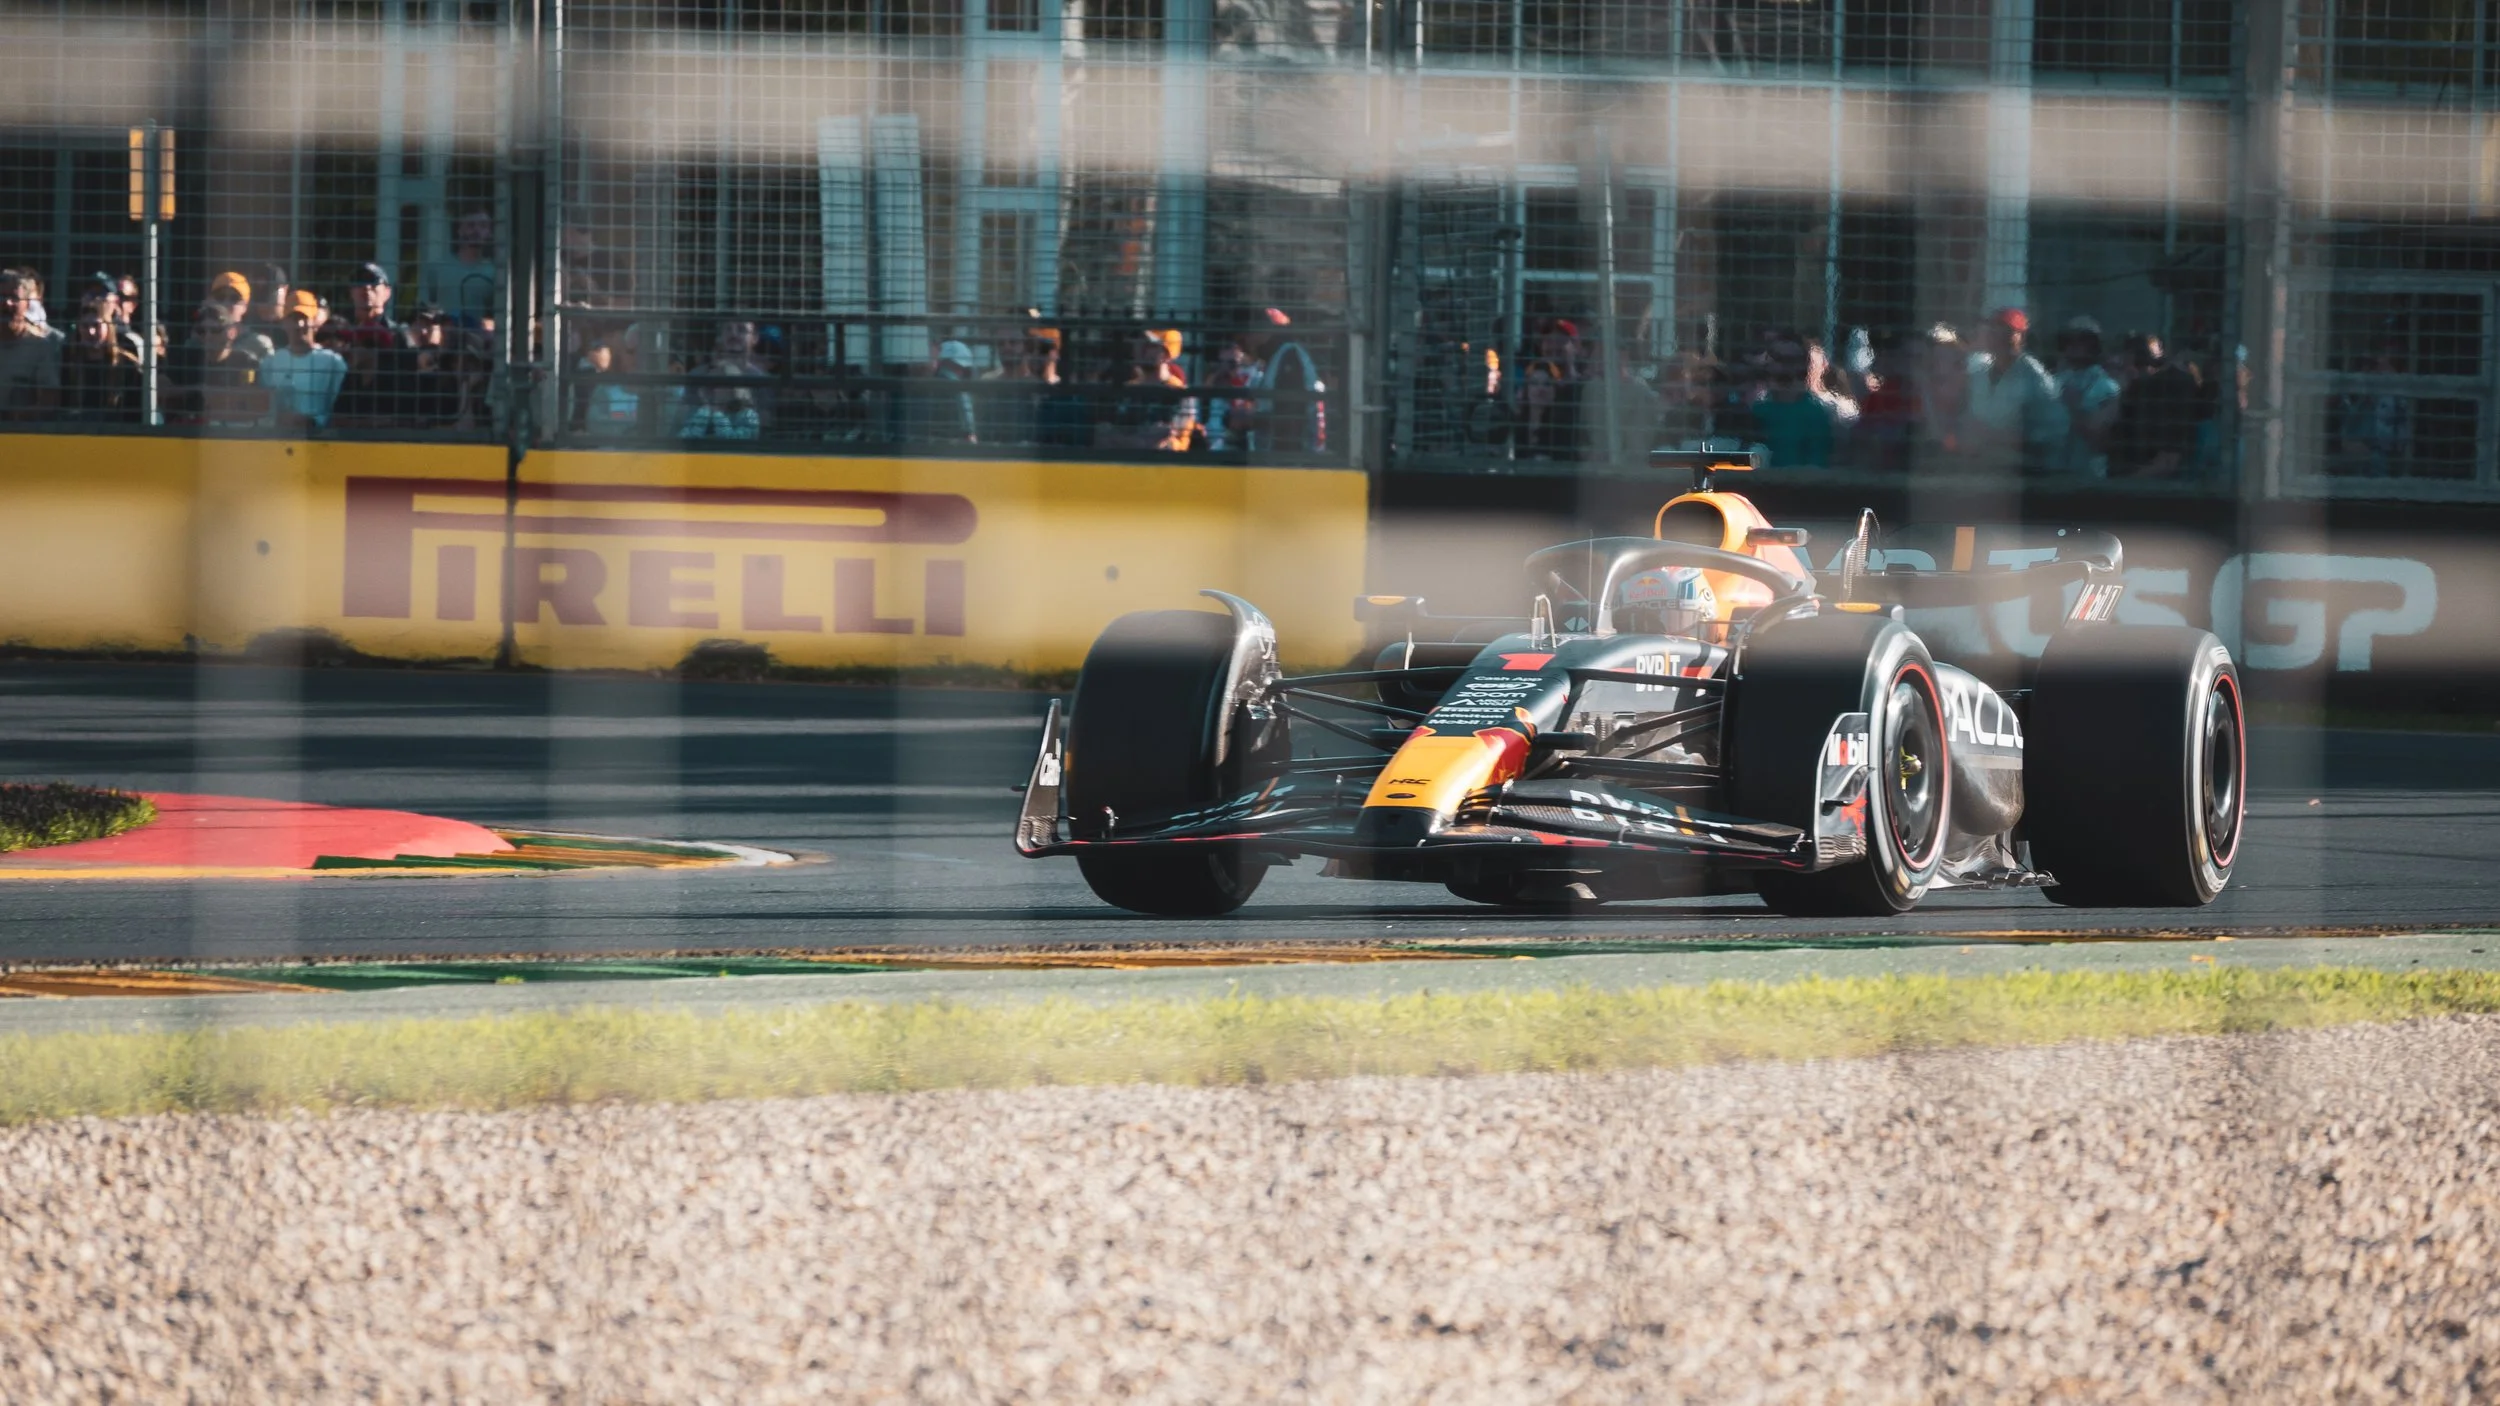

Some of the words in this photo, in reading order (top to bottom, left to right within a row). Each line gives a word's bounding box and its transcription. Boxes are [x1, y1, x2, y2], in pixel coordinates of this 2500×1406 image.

[343, 475, 978, 636] PIRELLI
[2070, 584, 2112, 621] Mobil
[1827, 733, 1868, 766] Mobil
